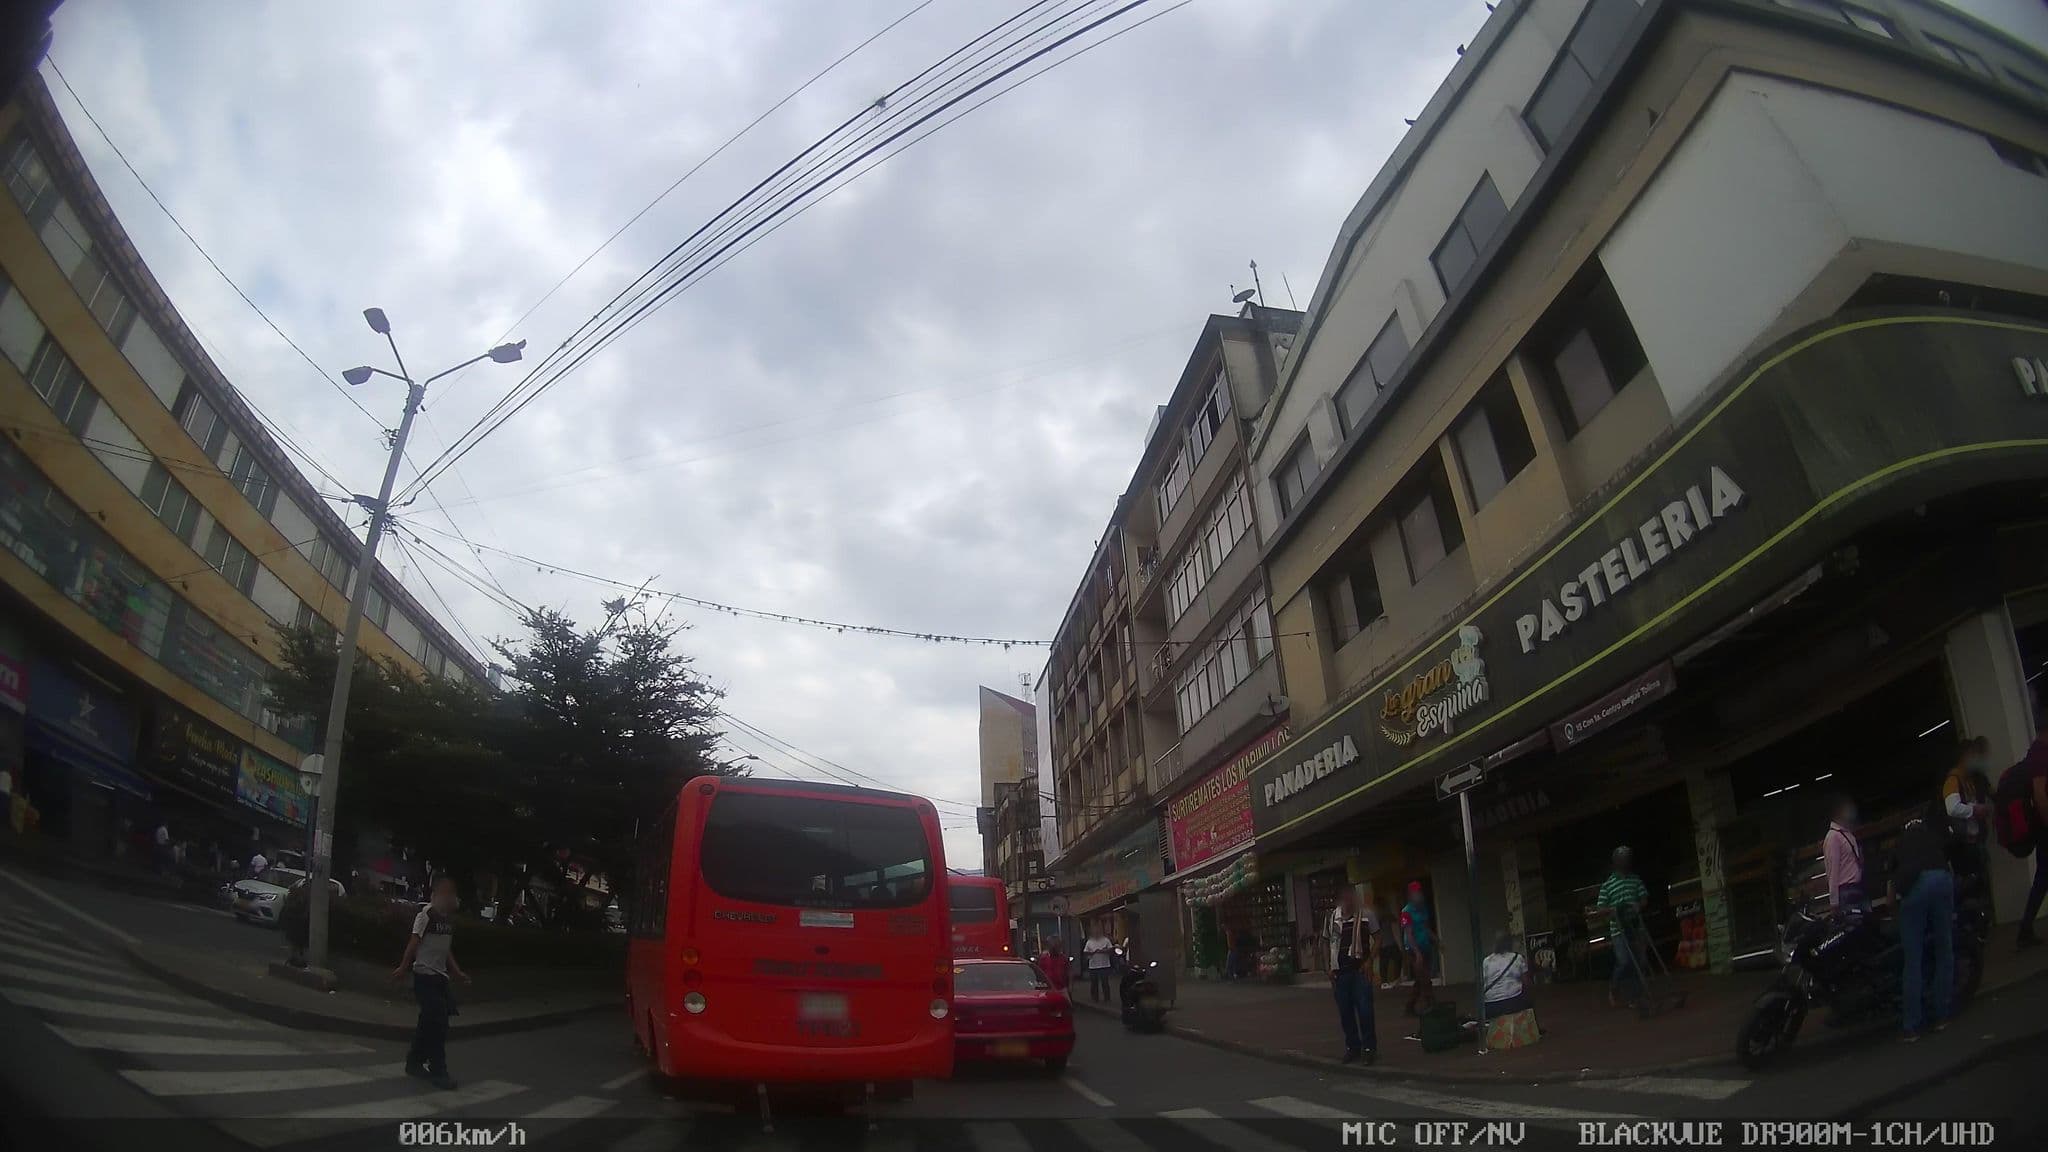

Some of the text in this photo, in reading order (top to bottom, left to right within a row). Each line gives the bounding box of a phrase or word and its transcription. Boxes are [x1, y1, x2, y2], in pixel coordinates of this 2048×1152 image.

[1515, 465, 1745, 654] PASTELERIA
[1416, 678, 1488, 738] Esquina
[1170, 775, 1221, 823] SURTIREMATES
[1221, 763, 1239, 793] LOS
[1263, 735, 1361, 808] PANADERIA
